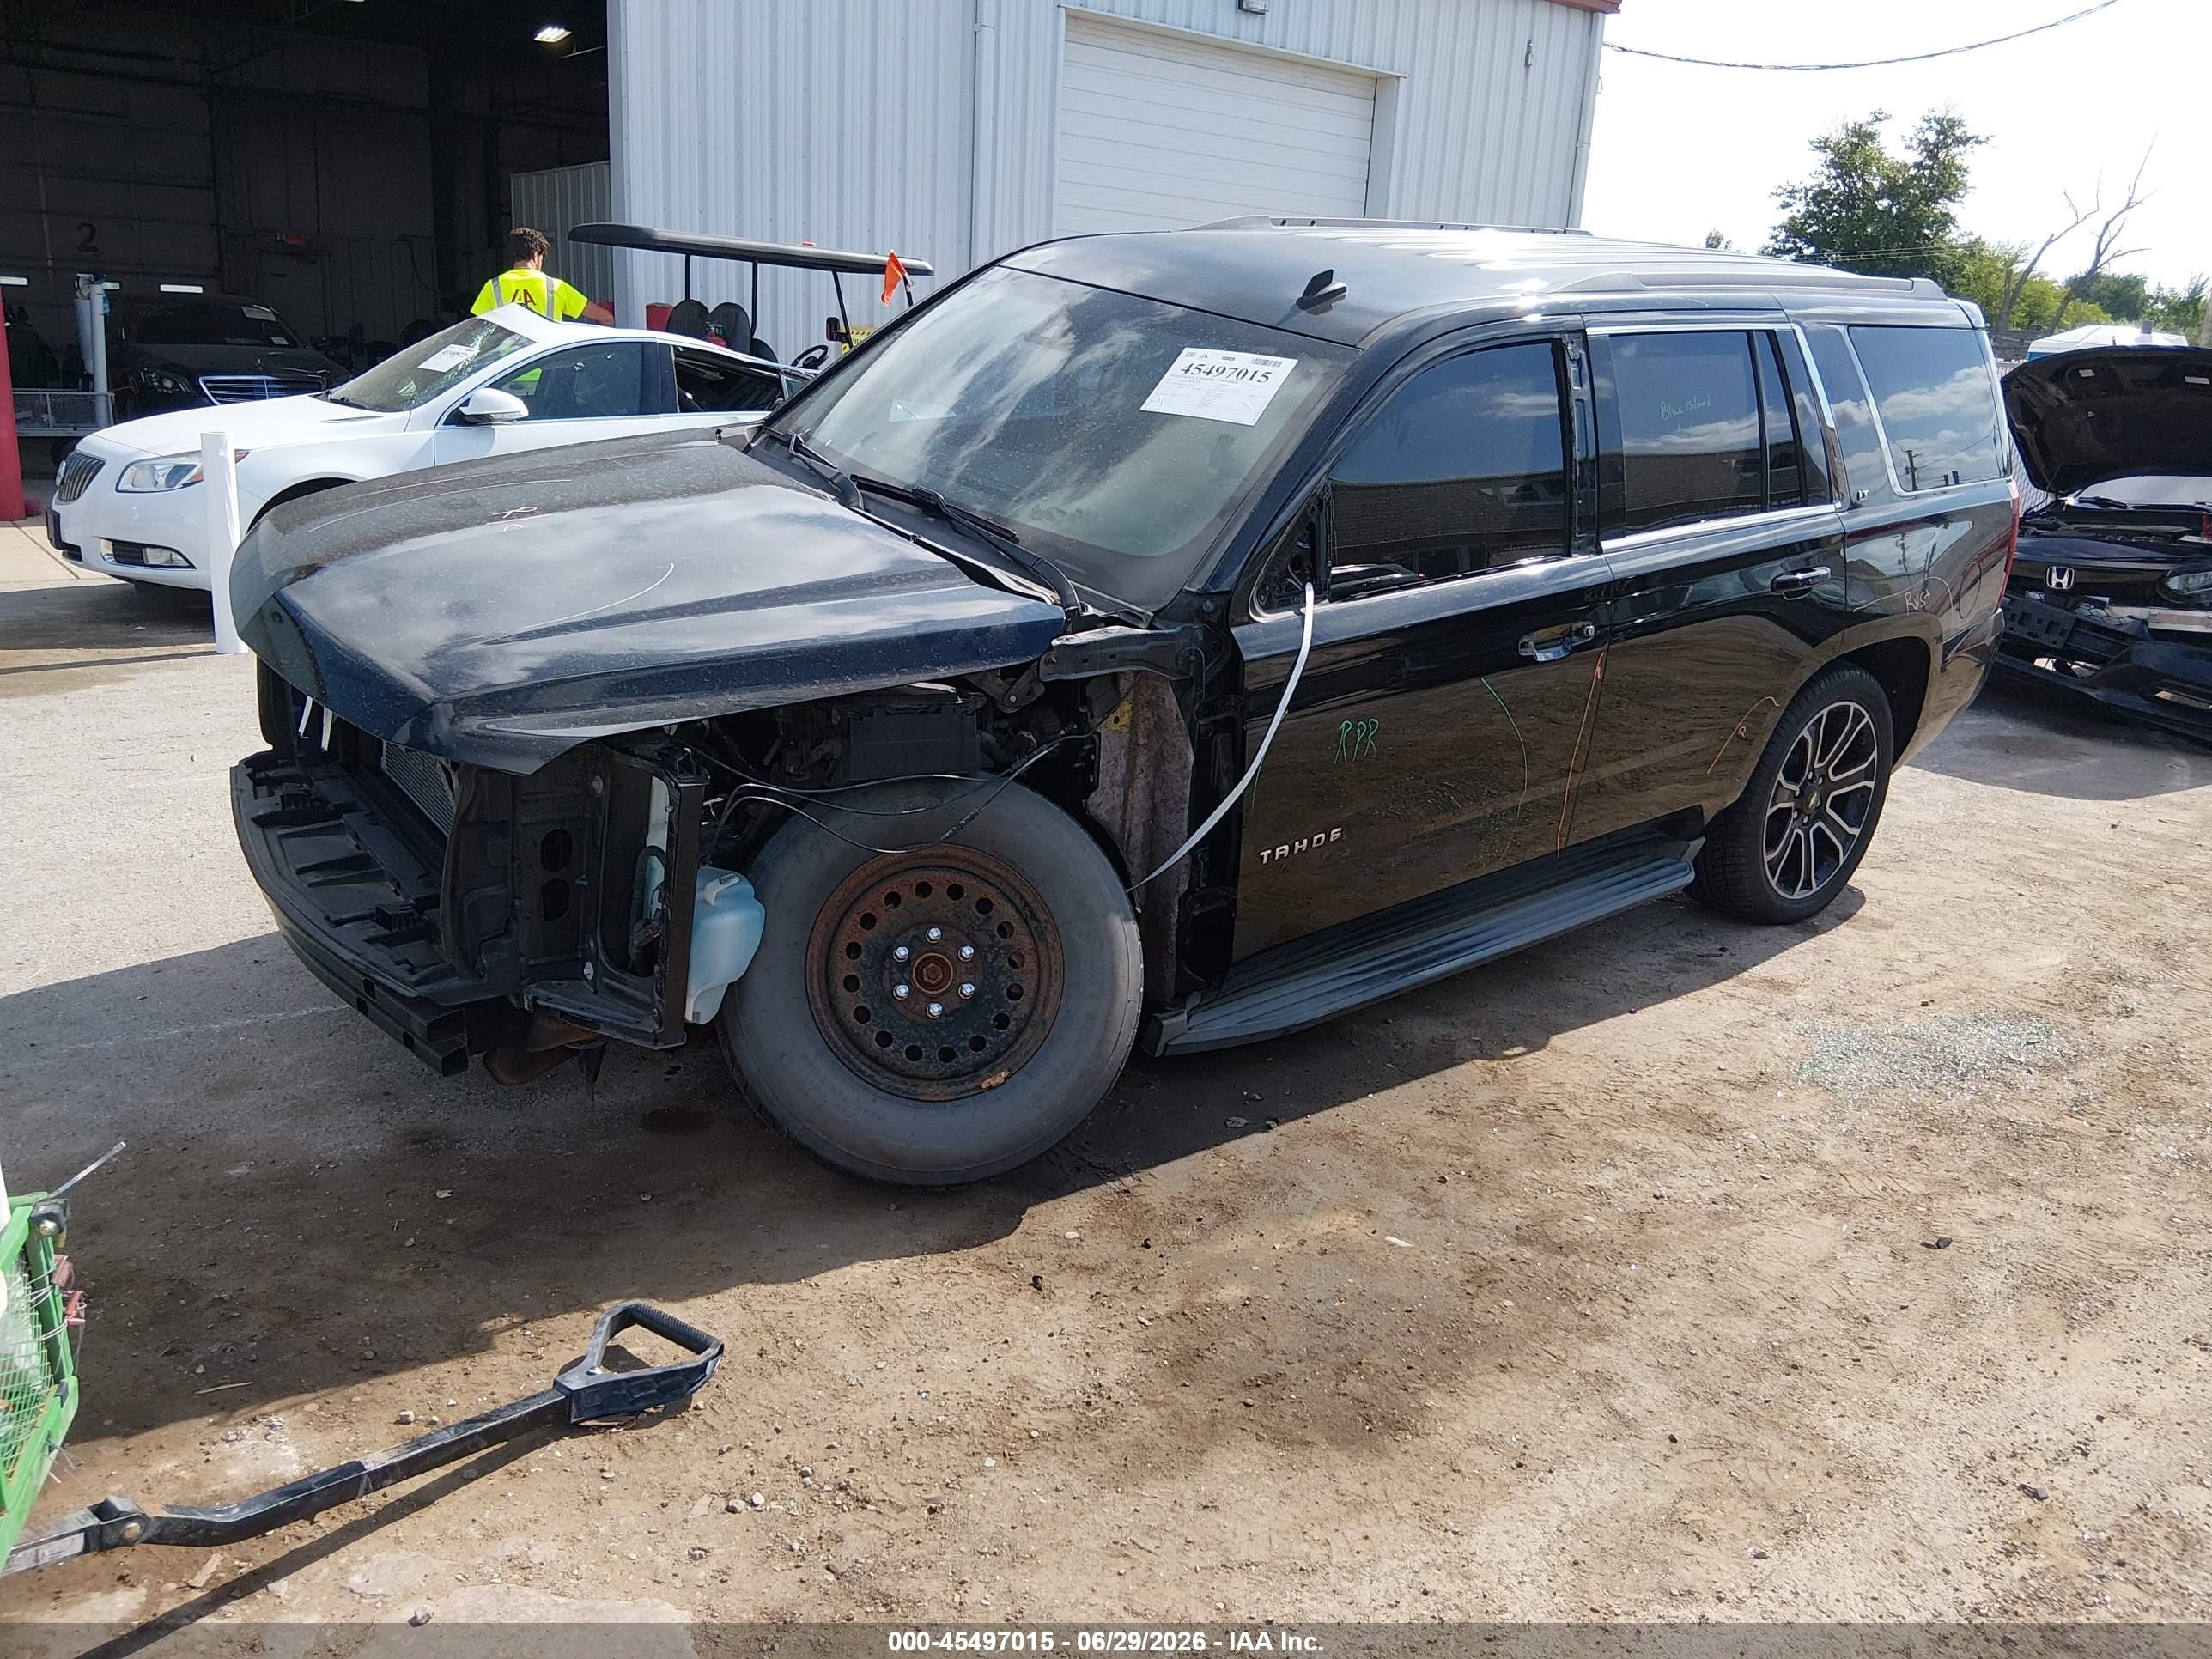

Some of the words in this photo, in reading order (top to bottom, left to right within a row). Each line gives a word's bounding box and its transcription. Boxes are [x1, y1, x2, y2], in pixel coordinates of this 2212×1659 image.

[76, 222, 99, 252] 2
[1181, 362, 1273, 384] 45497015
[1259, 827, 1342, 866] TAHOE
